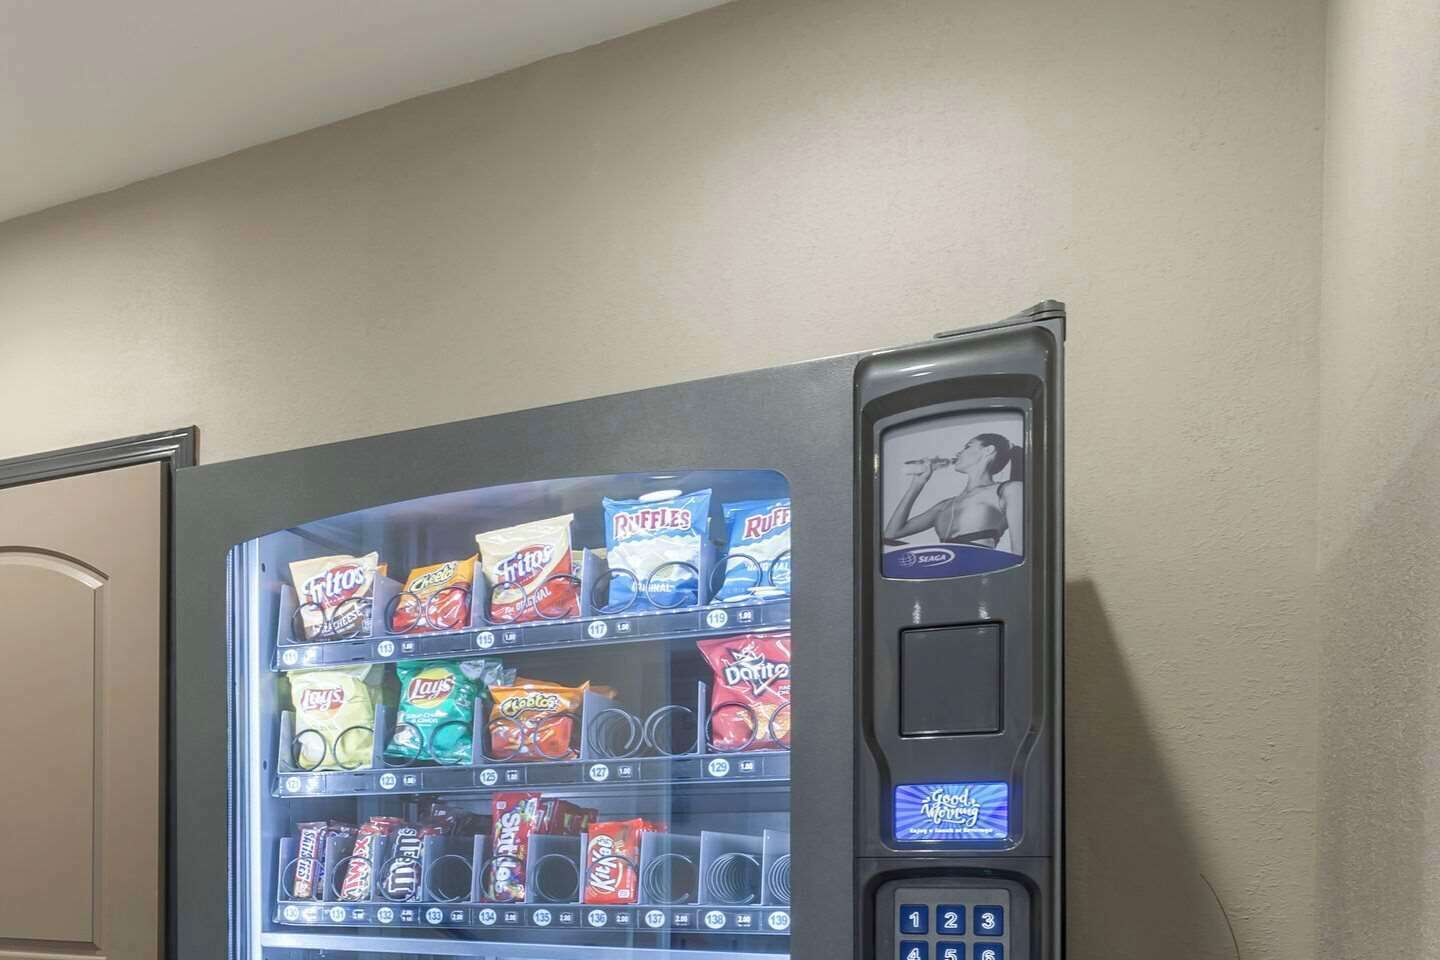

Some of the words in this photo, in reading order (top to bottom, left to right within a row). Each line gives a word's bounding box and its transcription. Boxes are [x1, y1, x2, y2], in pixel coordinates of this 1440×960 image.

[613, 508, 691, 540] RUFFLES
[493, 544, 555, 582] Fritos
[918, 554, 946, 563] SEAGA
[302, 566, 366, 604] Fritos
[708, 612, 727, 625] 119
[589, 623, 607, 635] 117
[477, 633, 495, 646] 115
[410, 677, 456, 700] Lay's
[590, 767, 608, 779] 127
[710, 761, 728, 774] 129
[481, 771, 497, 783] 125
[932, 788, 971, 806] Good
[921, 804, 980, 826] Morning
[495, 812, 521, 893] Skittles
[480, 911, 495, 922] 134
[534, 911, 550, 923] 135
[589, 912, 606, 924] 136
[646, 912, 664, 925] 137
[706, 914, 725, 926] 138
[769, 914, 789, 927] 139
[909, 911, 920, 928] 1
[944, 912, 958, 928] 2
[981, 912, 995, 929] 3
